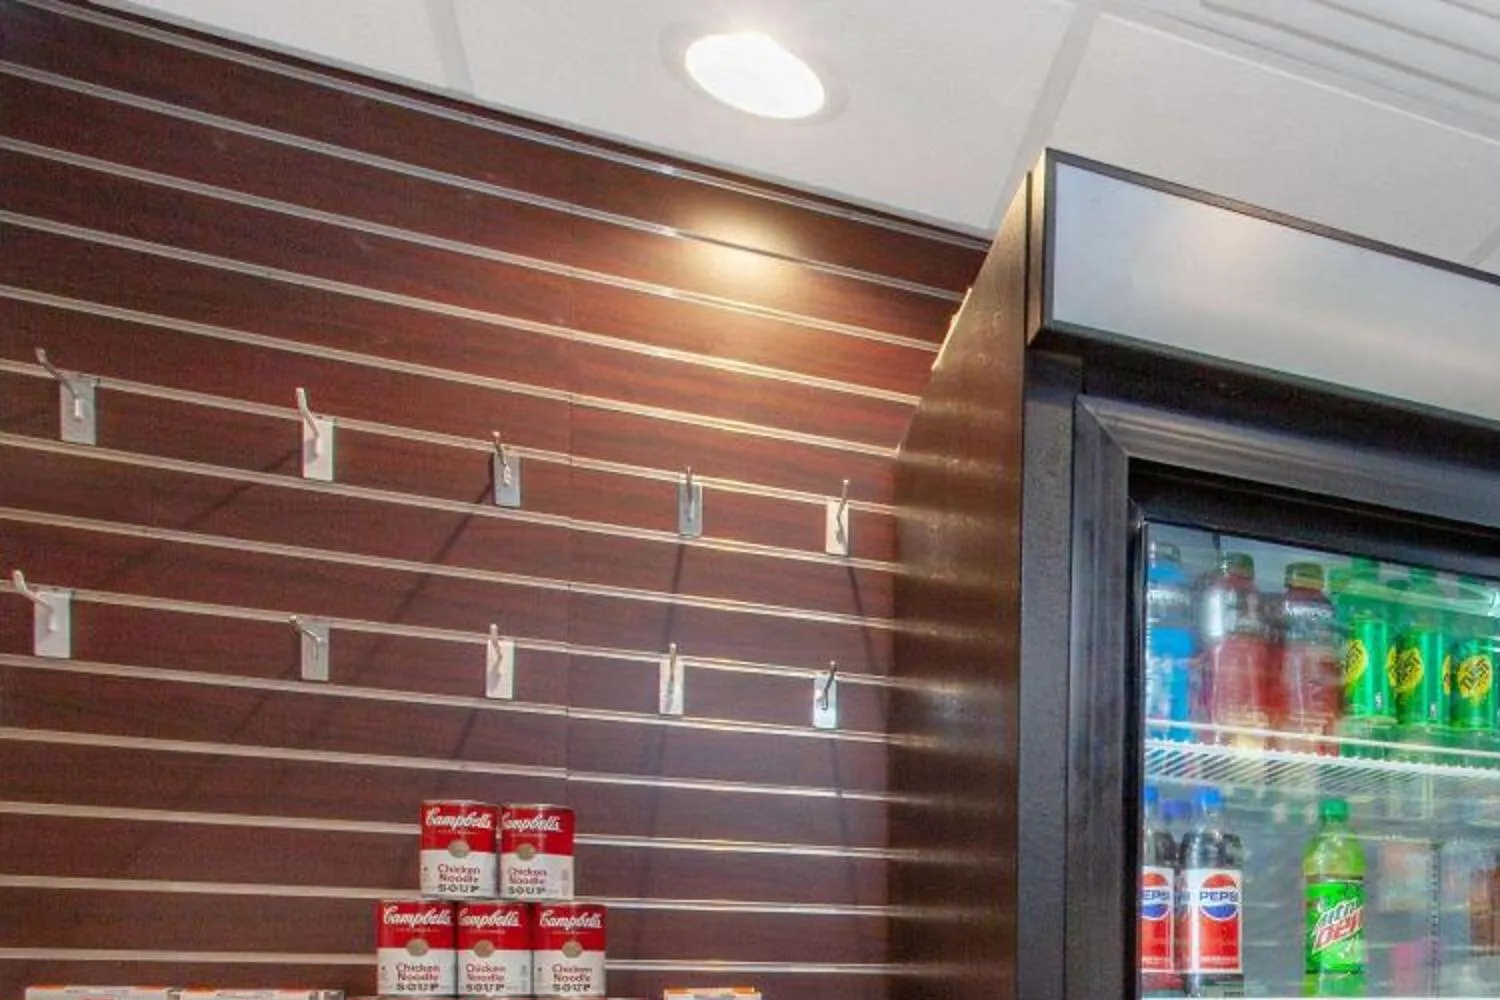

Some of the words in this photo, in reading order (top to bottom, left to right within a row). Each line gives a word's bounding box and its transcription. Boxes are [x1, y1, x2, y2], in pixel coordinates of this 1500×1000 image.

[437, 883, 480, 893] SOUP
[396, 982, 439, 992] SOUP
[552, 983, 591, 993] SOUP
